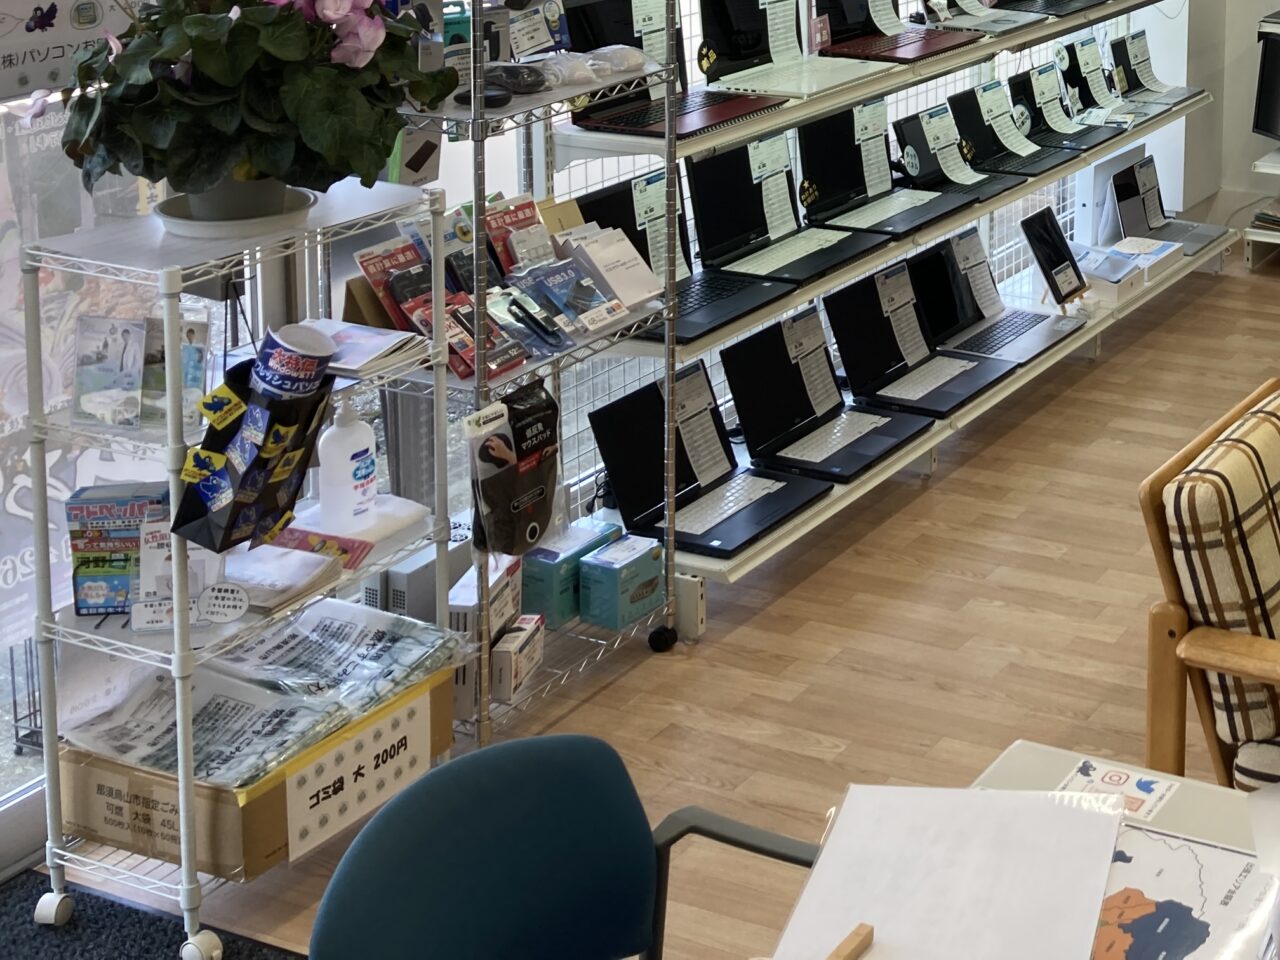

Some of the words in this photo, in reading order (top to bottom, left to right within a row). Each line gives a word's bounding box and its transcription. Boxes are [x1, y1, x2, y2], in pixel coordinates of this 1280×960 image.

[544, 269, 576, 287] USB3.0
[308, 776, 345, 810] ゴミ袋
[353, 764, 366, 784] 大
[373, 735, 409, 771] 200円
